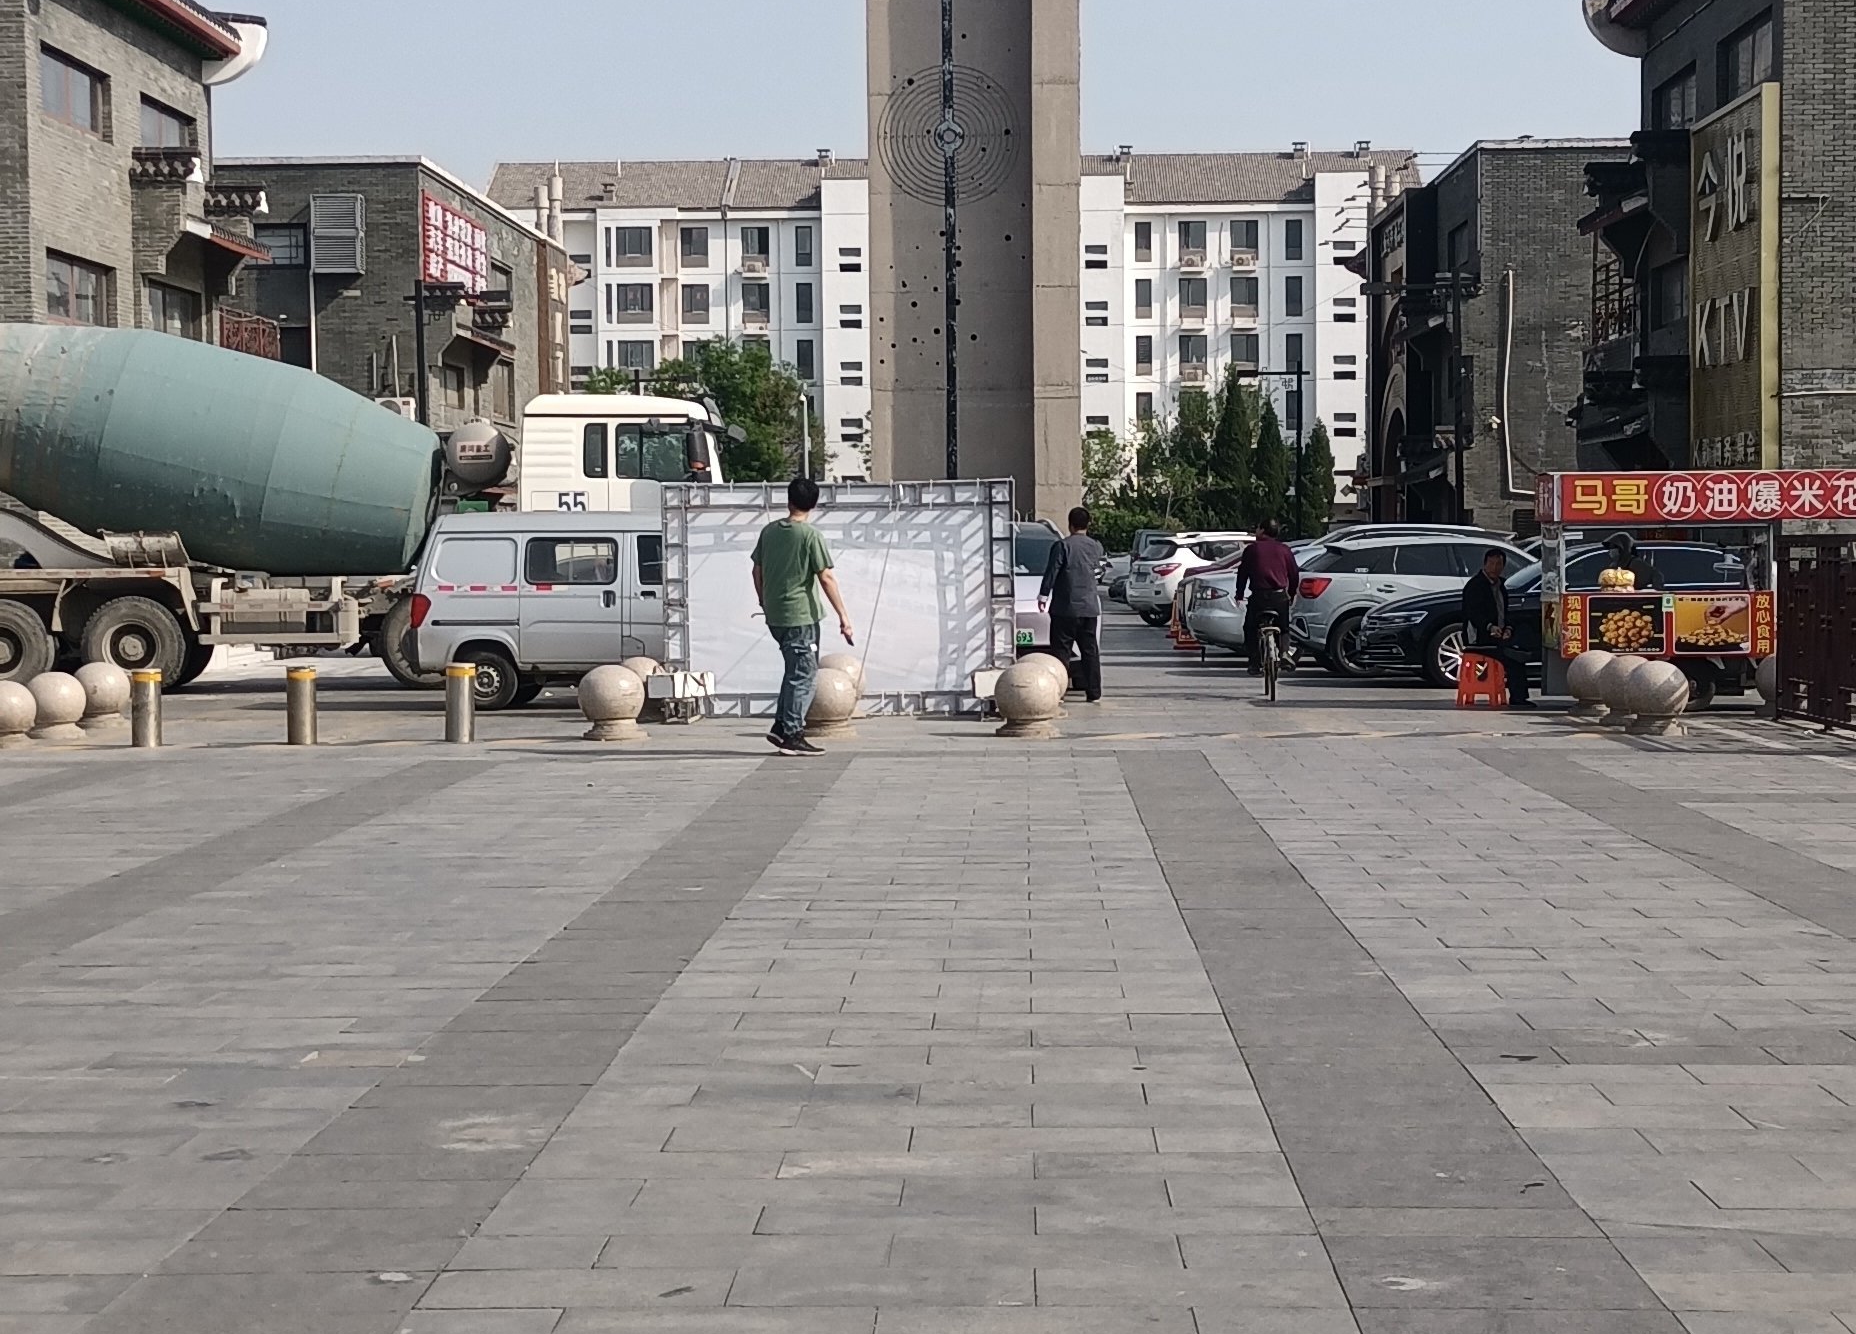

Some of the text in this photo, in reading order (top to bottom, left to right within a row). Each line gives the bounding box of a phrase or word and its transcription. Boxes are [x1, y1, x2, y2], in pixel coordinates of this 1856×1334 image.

[1697, 133, 1748, 242] 今悦
[1695, 287, 1750, 368] KTV
[558, 492, 587, 512] 55
[1571, 479, 1649, 515] 马哥
[1661, 478, 1856, 514] 奶油爆米花
[1016, 630, 1033, 643] 693
[1755, 595, 1771, 654] 放心食用
